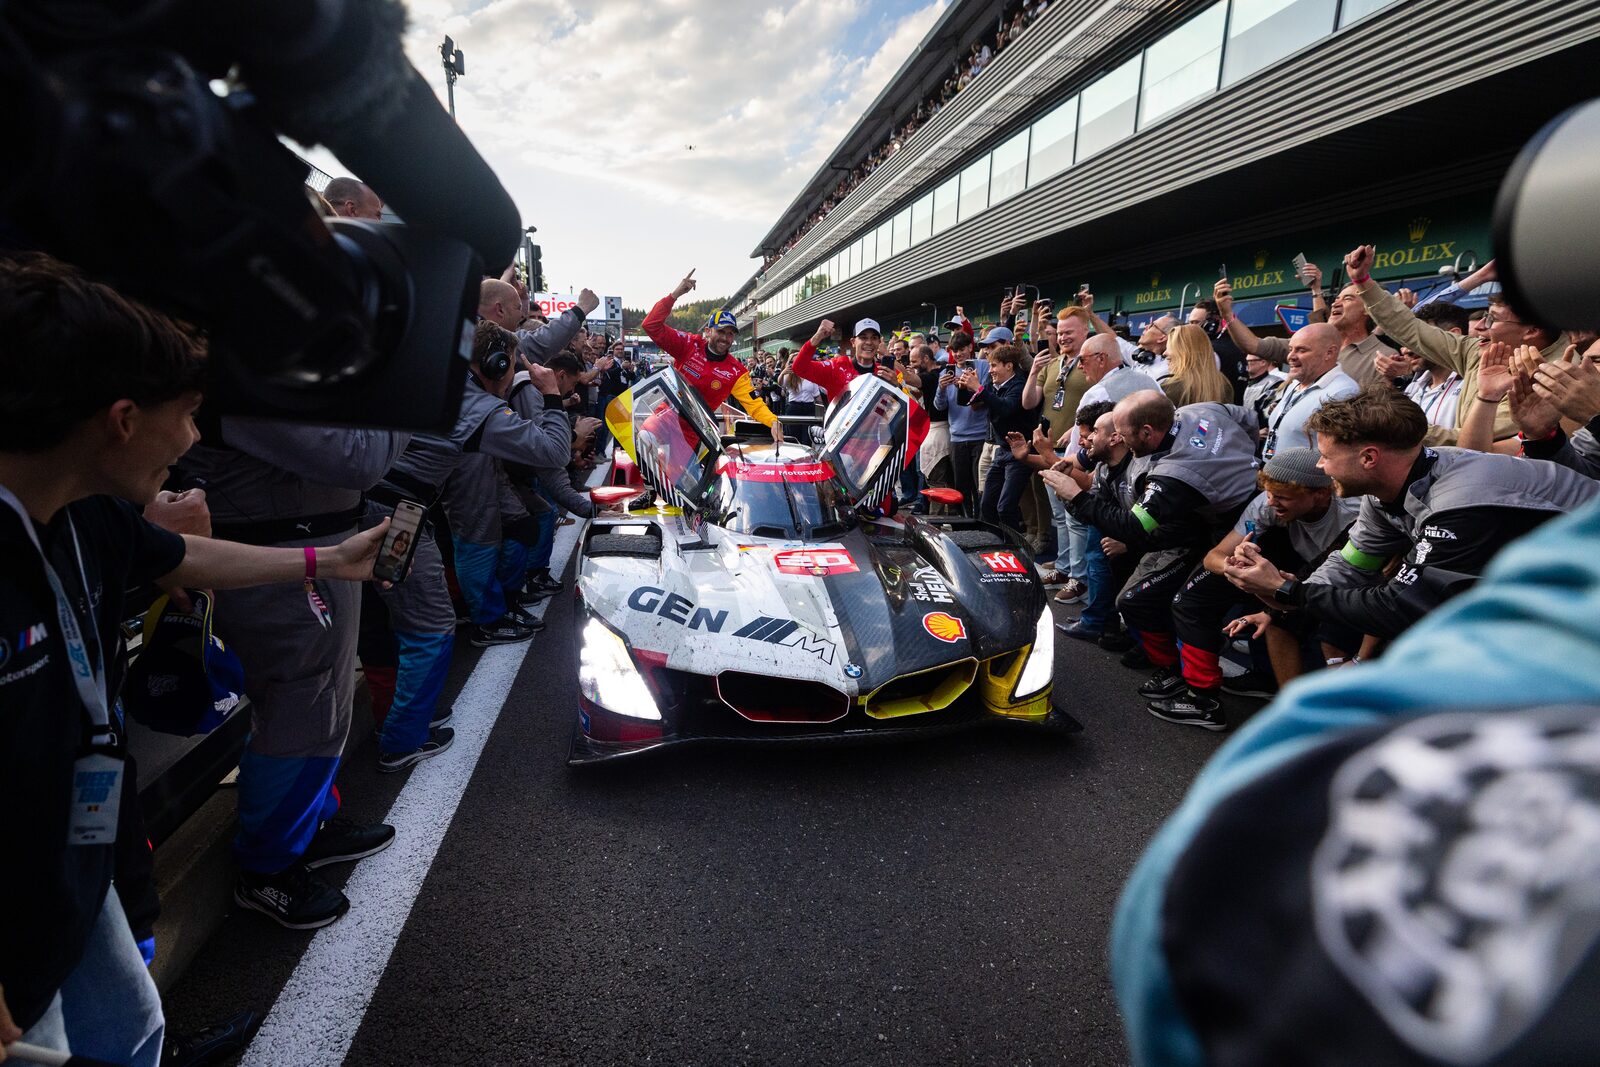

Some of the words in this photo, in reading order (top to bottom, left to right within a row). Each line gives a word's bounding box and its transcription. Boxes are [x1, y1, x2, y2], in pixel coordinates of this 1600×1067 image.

[1375, 241, 1456, 269] ROLEX
[1232, 270, 1284, 290] ROLEX
[1135, 288, 1172, 304] ROLEX
[538, 297, 577, 316] gies
[1289, 314, 1305, 325] 15
[1211, 427, 1223, 455] Motorsport
[778, 468, 824, 476] Motorsport
[1424, 528, 1458, 540] HELIX
[983, 555, 1018, 569] HY
[1150, 561, 1185, 585] Motorsport
[1194, 570, 1211, 584] Moto
[908, 582, 931, 602] Shell
[912, 565, 954, 604] HELIX
[627, 585, 729, 633] GEN
[163, 614, 202, 628] MICH
[0, 654, 50, 686] otorsport
